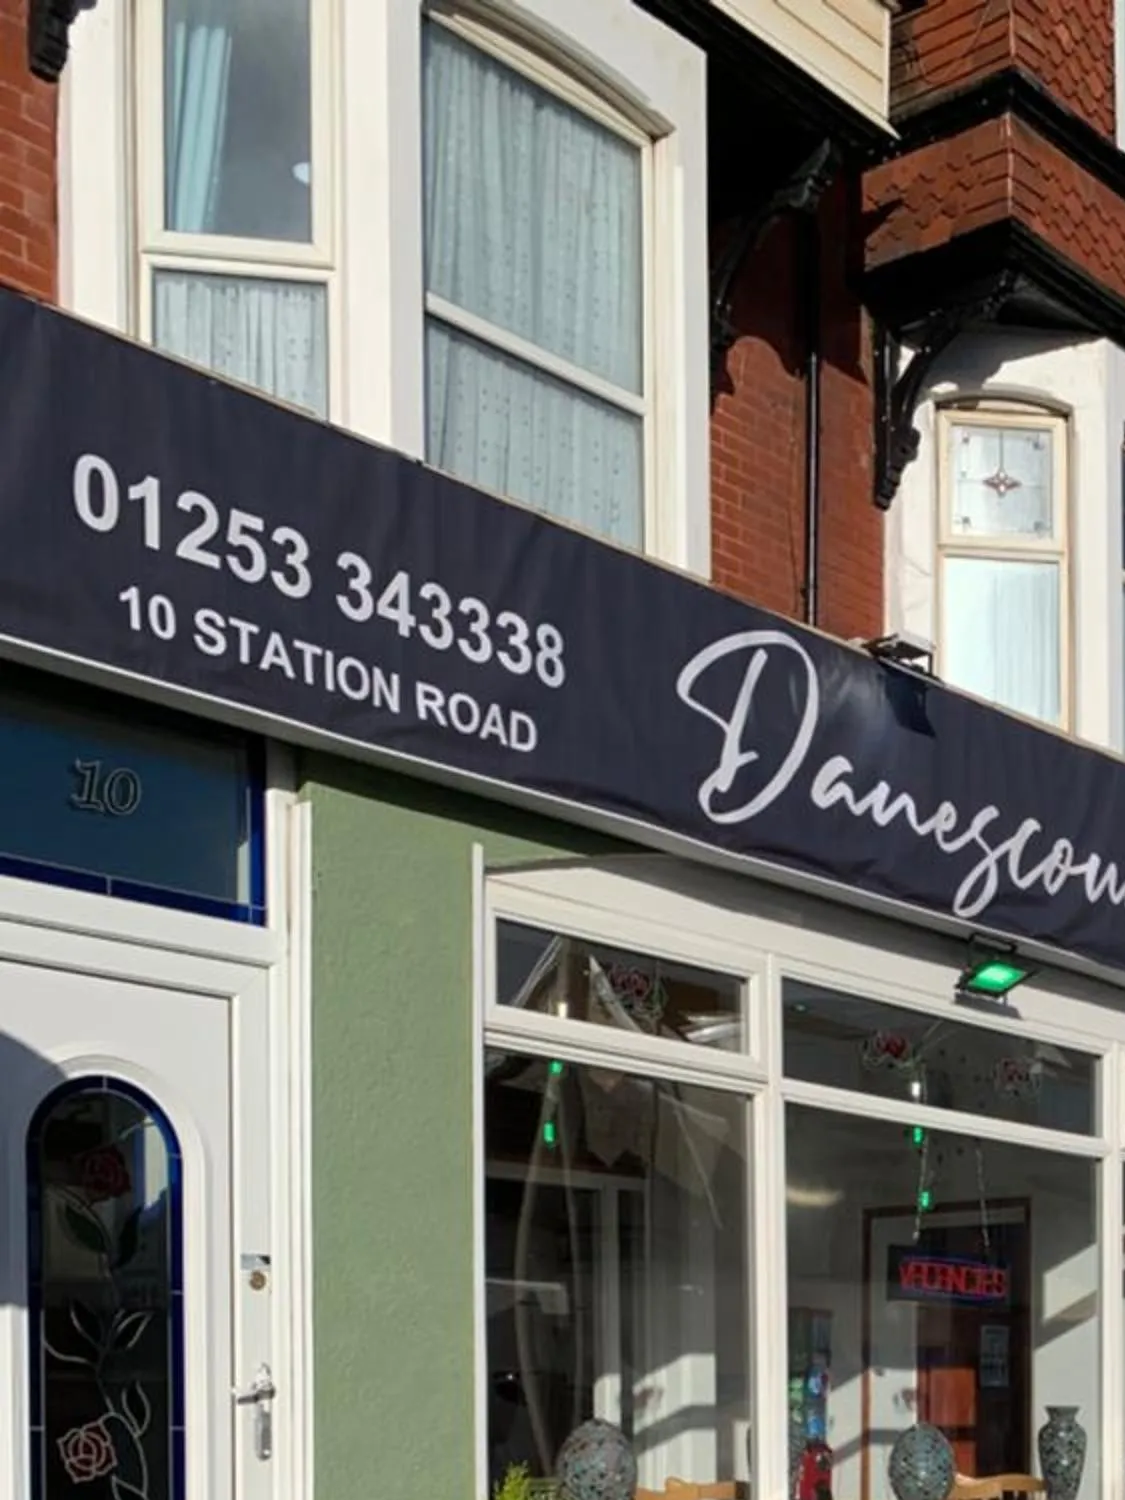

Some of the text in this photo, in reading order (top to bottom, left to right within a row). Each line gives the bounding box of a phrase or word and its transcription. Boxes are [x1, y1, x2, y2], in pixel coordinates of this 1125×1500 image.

[73, 454, 566, 688] 01253 343338
[119, 585, 538, 753] 10 STATION ROAD
[69, 757, 142, 816] 10
